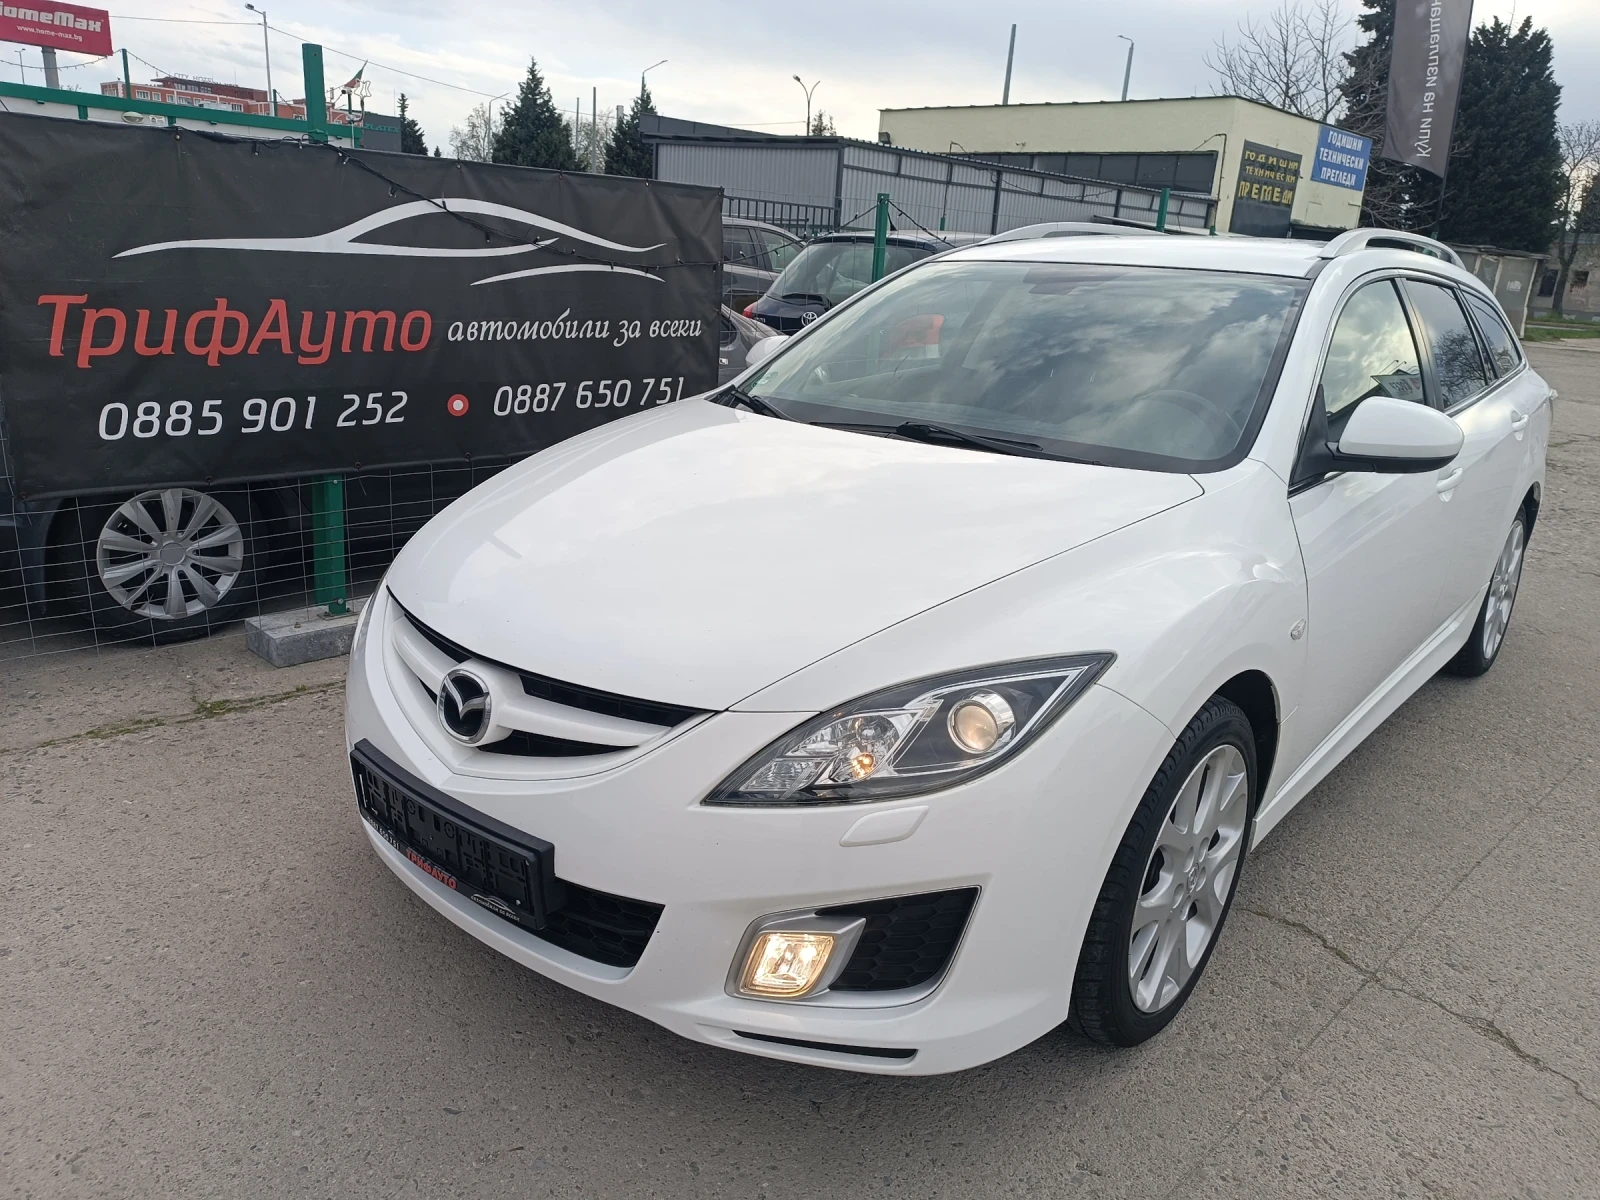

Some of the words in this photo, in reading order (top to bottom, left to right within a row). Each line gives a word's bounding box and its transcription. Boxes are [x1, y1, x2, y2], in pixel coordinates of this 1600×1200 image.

[0, 1, 102, 32] omeMax
[16, 25, 83, 42] www.home-max.bg
[1328, 130, 1363, 151] ГОДИШНИ
[1319, 147, 1364, 170] ТЕХНИЧЕСКИ
[1320, 166, 1357, 187] ПРЕГЛЕДИ
[37, 294, 432, 368] ТрифАуто
[447, 308, 610, 342] автомобили
[613, 319, 641, 347] за
[649, 319, 702, 338] всеки
[493, 382, 567, 416] 0887
[576, 379, 632, 408] 650
[640, 376, 685, 406] 751
[98, 399, 224, 441] 0885
[241, 396, 317, 433] 901
[336, 391, 409, 427] 252
[406, 848, 457, 890] ТРИФАУТО
